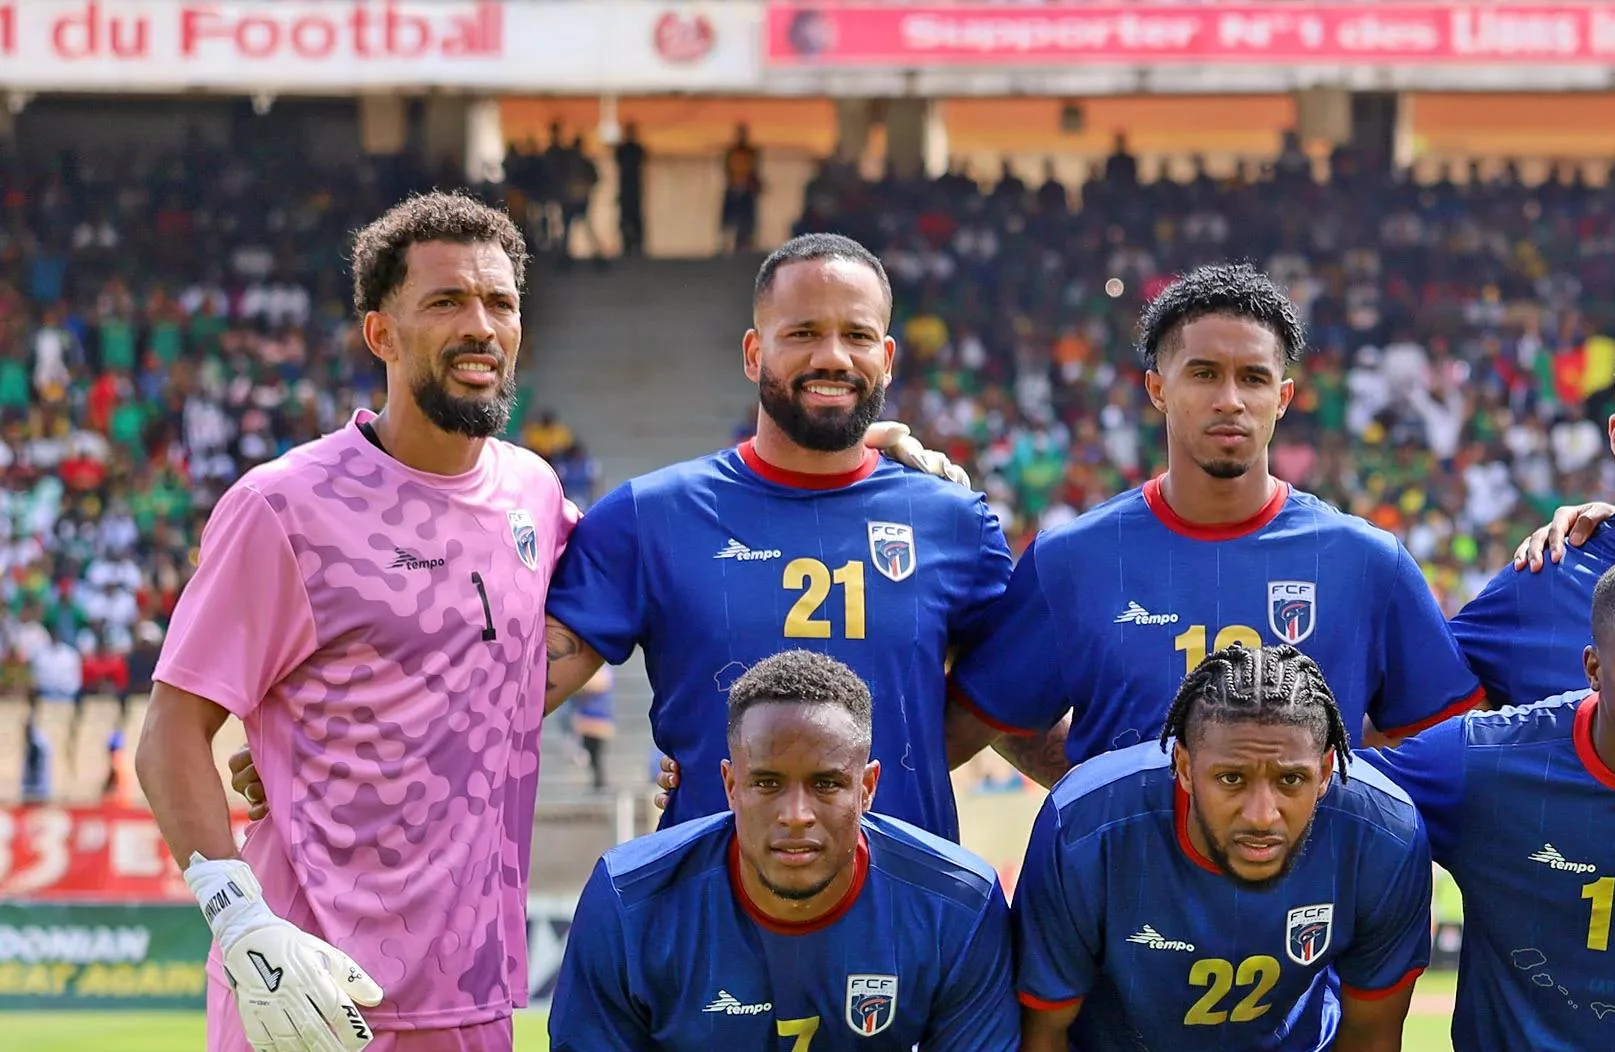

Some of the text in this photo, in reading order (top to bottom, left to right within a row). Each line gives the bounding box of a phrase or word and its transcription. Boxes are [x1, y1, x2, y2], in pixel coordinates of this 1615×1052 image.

[51, 4, 148, 58] du
[903, 14, 1199, 50] Supporter
[871, 525, 907, 536] FCF
[736, 548, 782, 561] tempo
[406, 557, 445, 570] tempo
[1272, 584, 1311, 595] FCF
[782, 557, 866, 640] 21
[471, 571, 497, 641] 1
[1135, 613, 1179, 626] tempo
[1549, 859, 1596, 873] tempo
[1290, 907, 1330, 921] FCF
[1149, 938, 1195, 953] tempo
[851, 978, 893, 990] FCF
[1184, 954, 1281, 1025] 22
[726, 1002, 772, 1016] tempo
